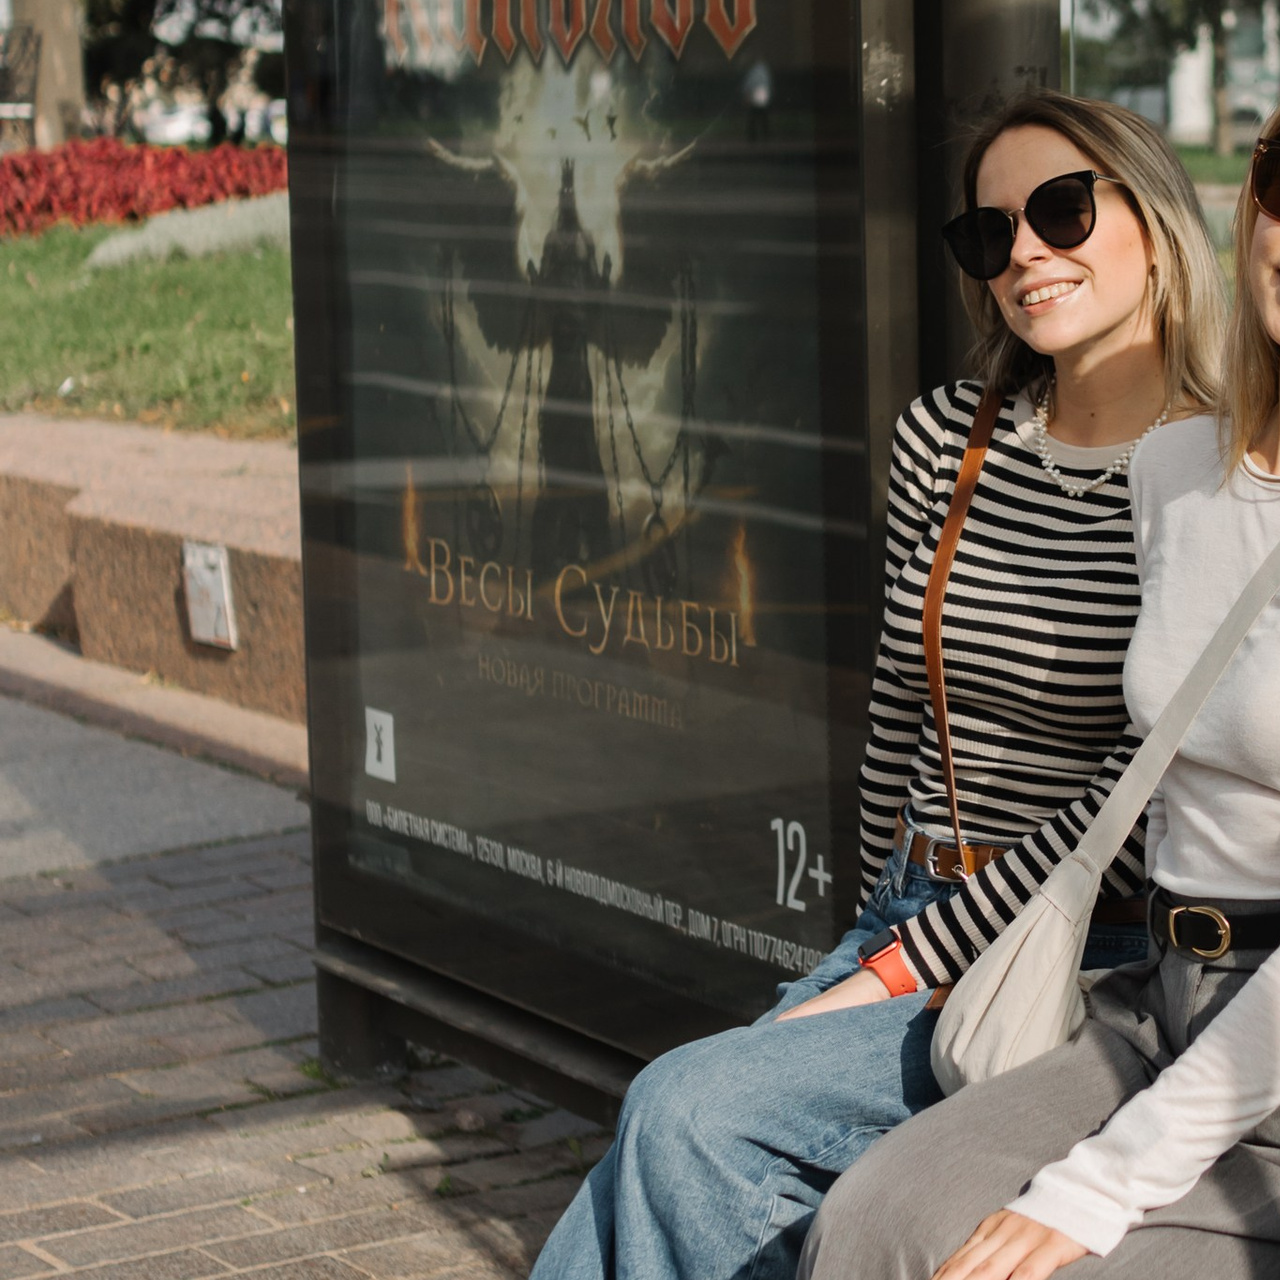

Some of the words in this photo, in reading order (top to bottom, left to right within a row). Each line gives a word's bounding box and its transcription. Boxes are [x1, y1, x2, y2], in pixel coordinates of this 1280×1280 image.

[477, 652, 546, 697] НОВАЯ
[770, 816, 833, 913] 12+
[688, 908, 711, 940] ДОМ
[721, 919, 747, 955] ОГРН
